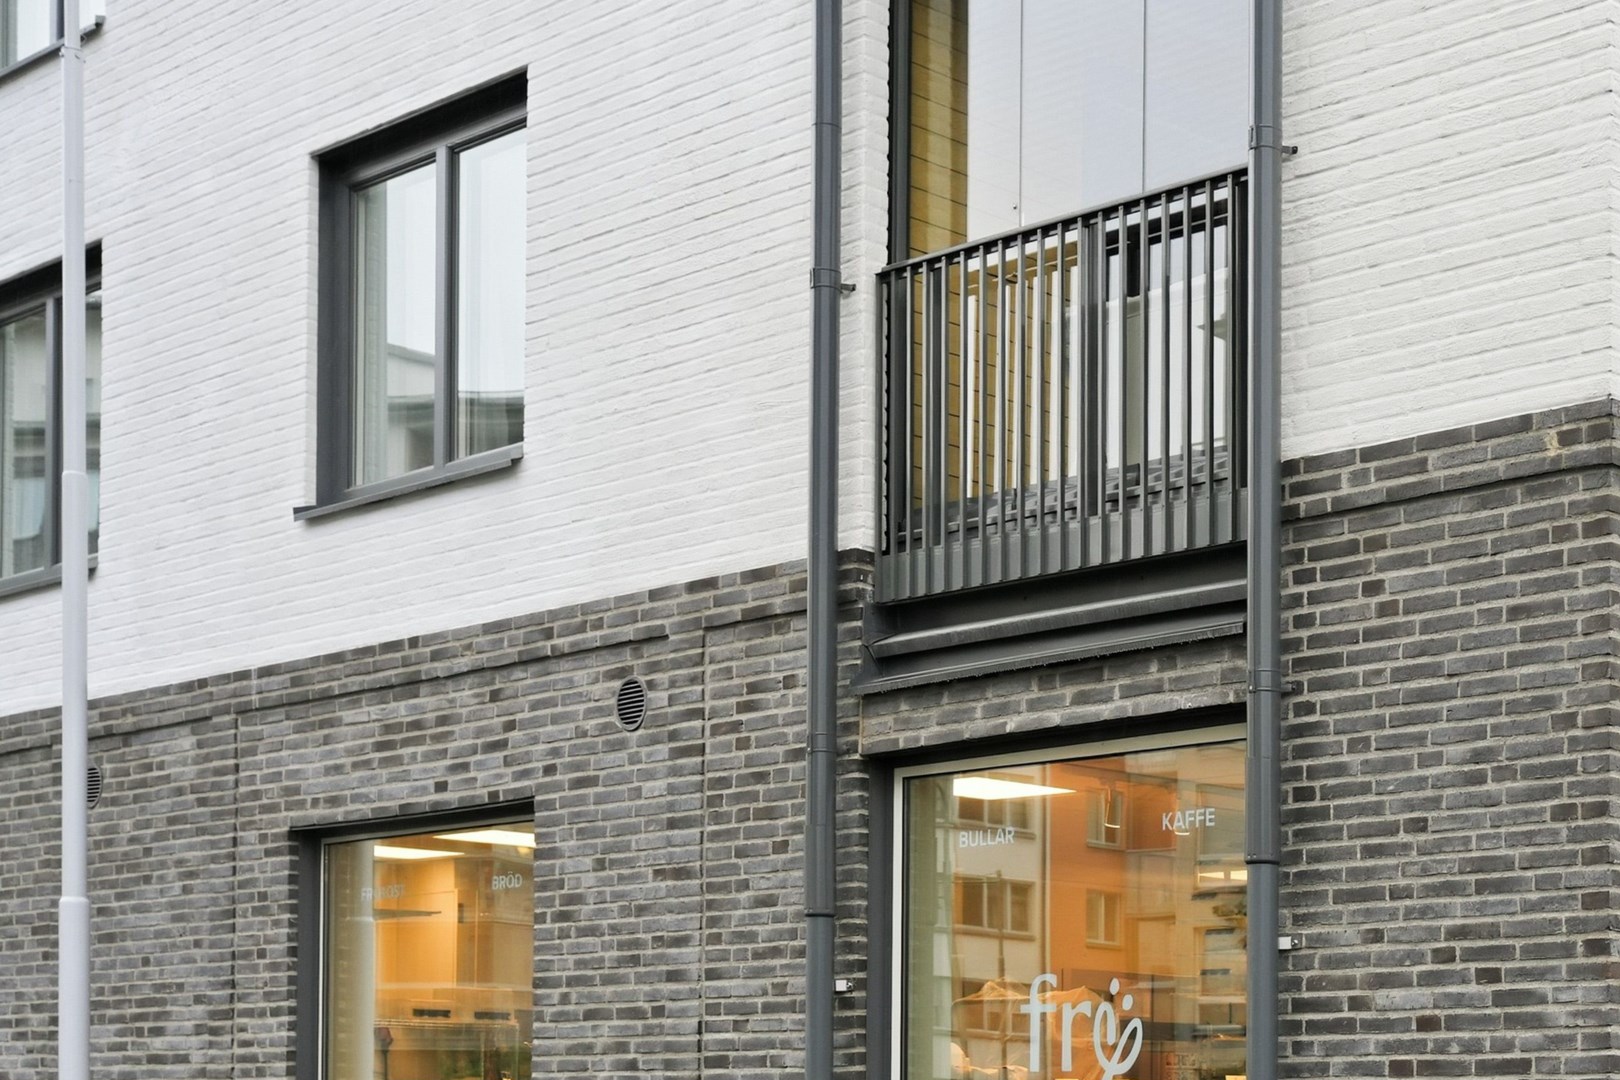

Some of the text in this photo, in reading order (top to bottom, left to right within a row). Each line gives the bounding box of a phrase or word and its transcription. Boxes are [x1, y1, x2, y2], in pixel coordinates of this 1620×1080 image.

[1162, 808, 1216, 832] KAFFE
[959, 826, 1016, 848] BULLAR
[492, 870, 523, 890] BRÖD
